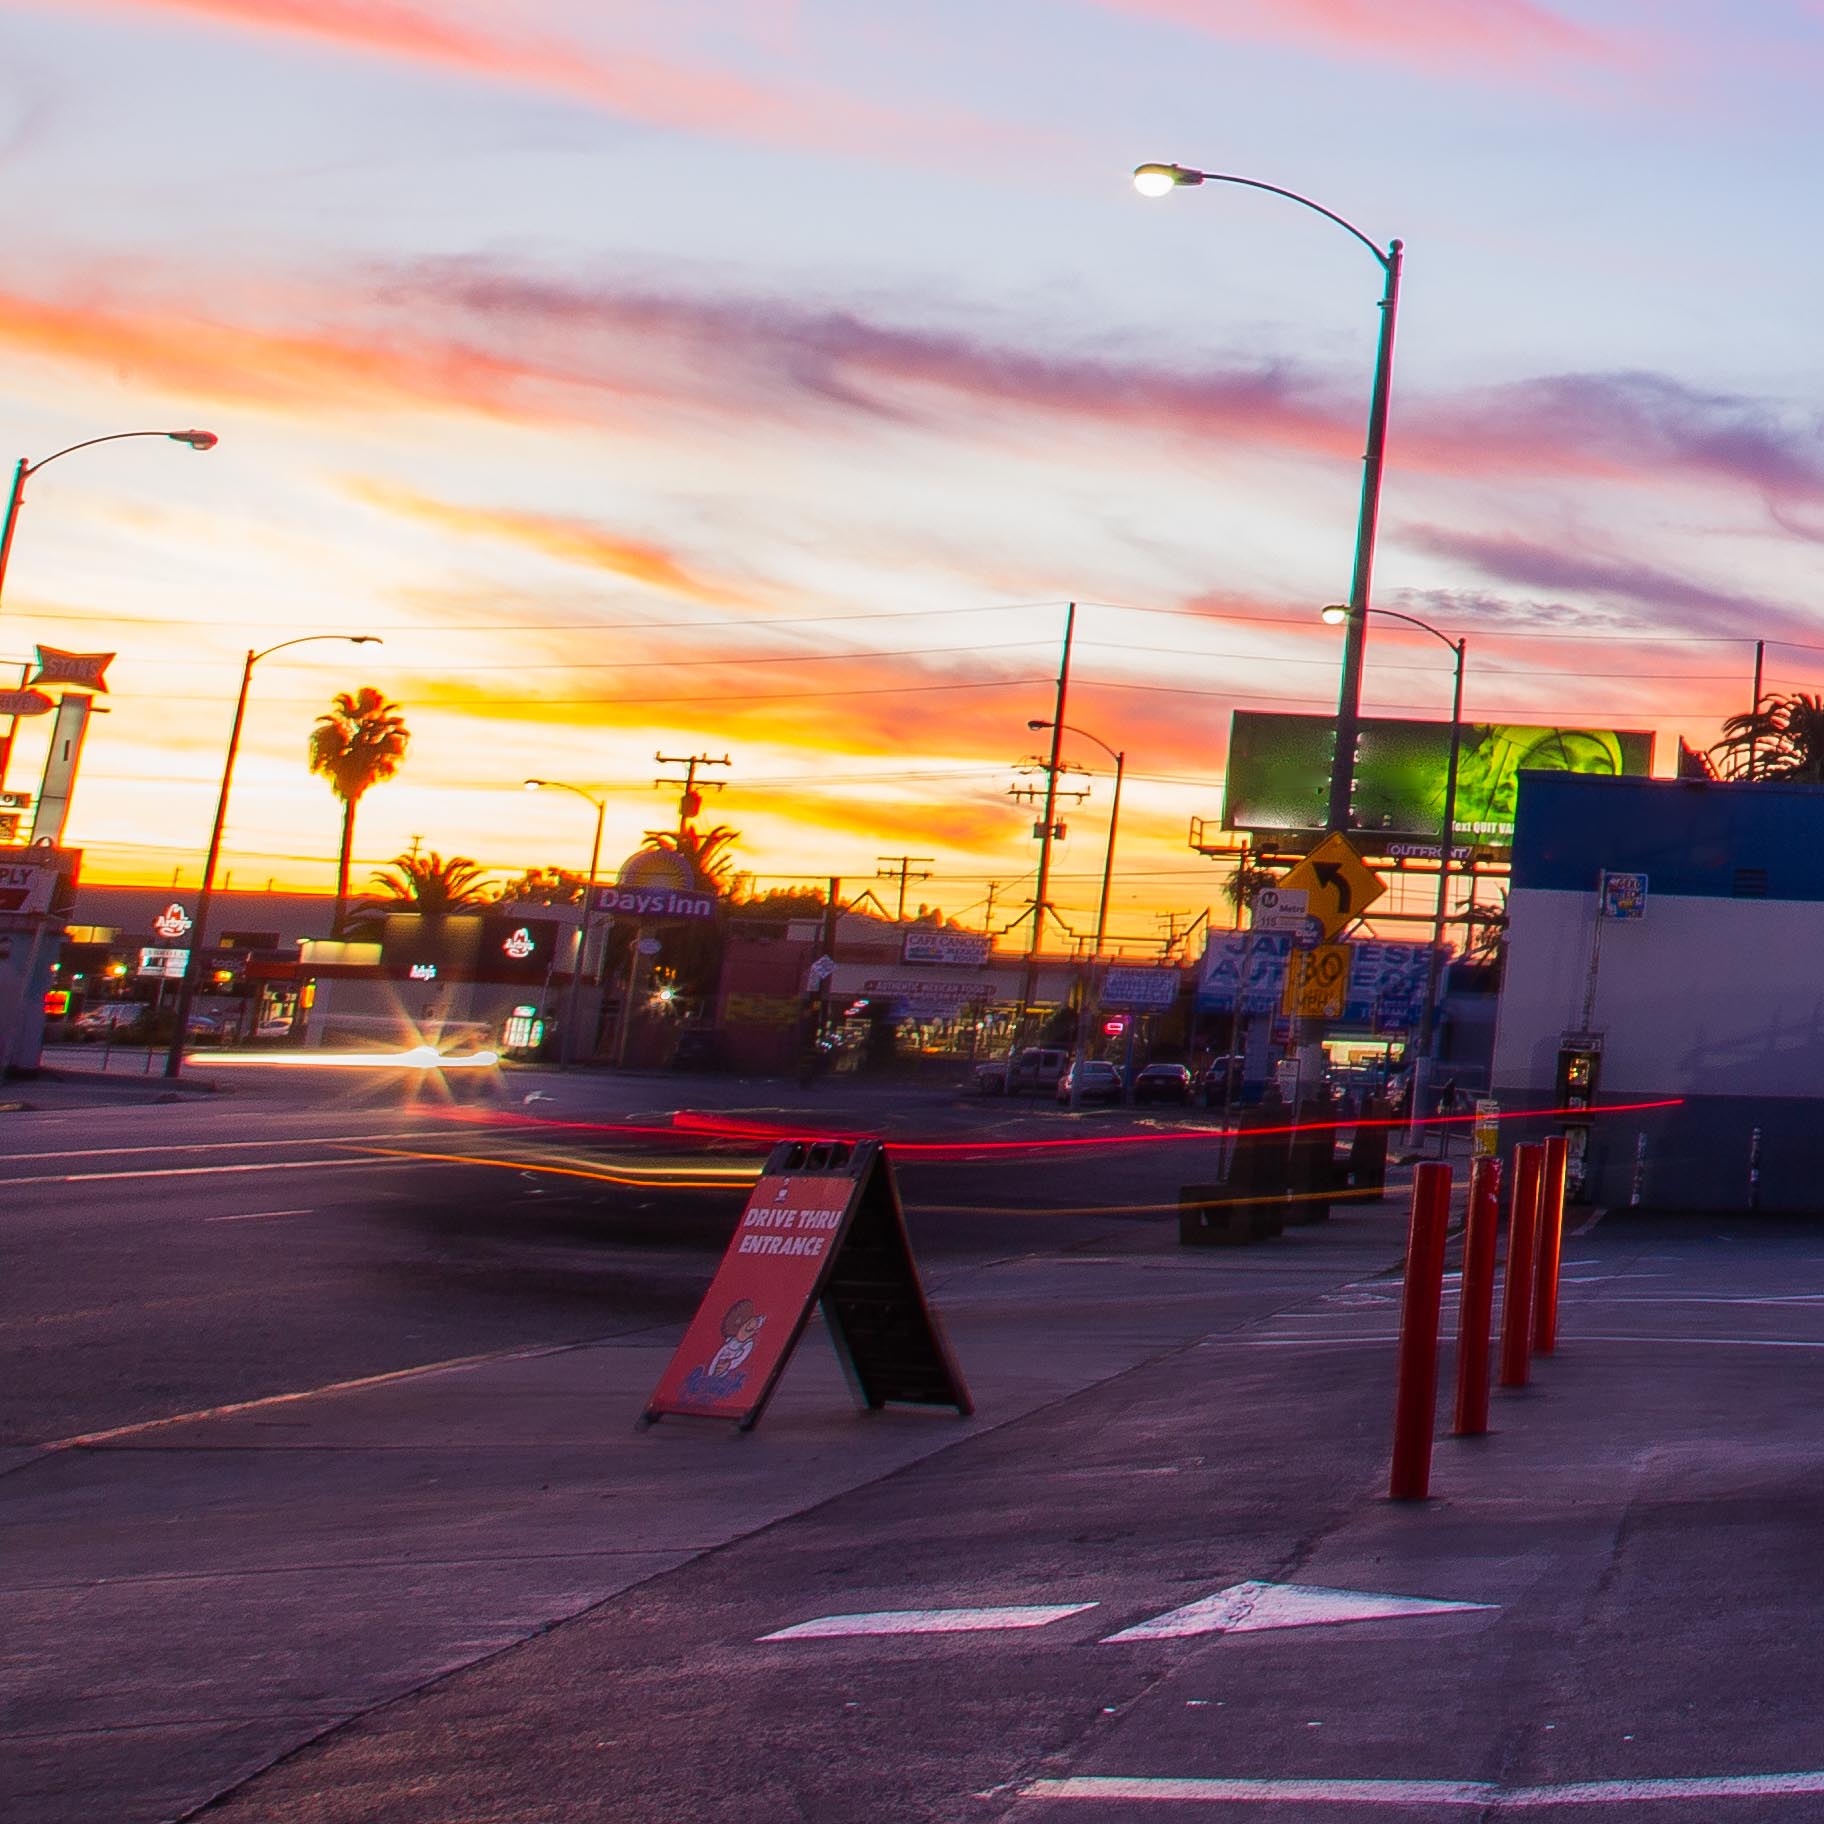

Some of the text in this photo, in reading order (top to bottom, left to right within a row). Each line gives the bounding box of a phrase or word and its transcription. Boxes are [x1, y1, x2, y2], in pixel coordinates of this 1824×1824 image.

[1473, 822, 1497, 834] QUIT
[600, 888, 711, 915] Days Inn
[1280, 904, 1305, 913] Metro
[1299, 952, 1343, 987] 30
[744, 1208, 842, 1229] DRIVE THRU
[738, 1235, 825, 1256] ENTRANCE
